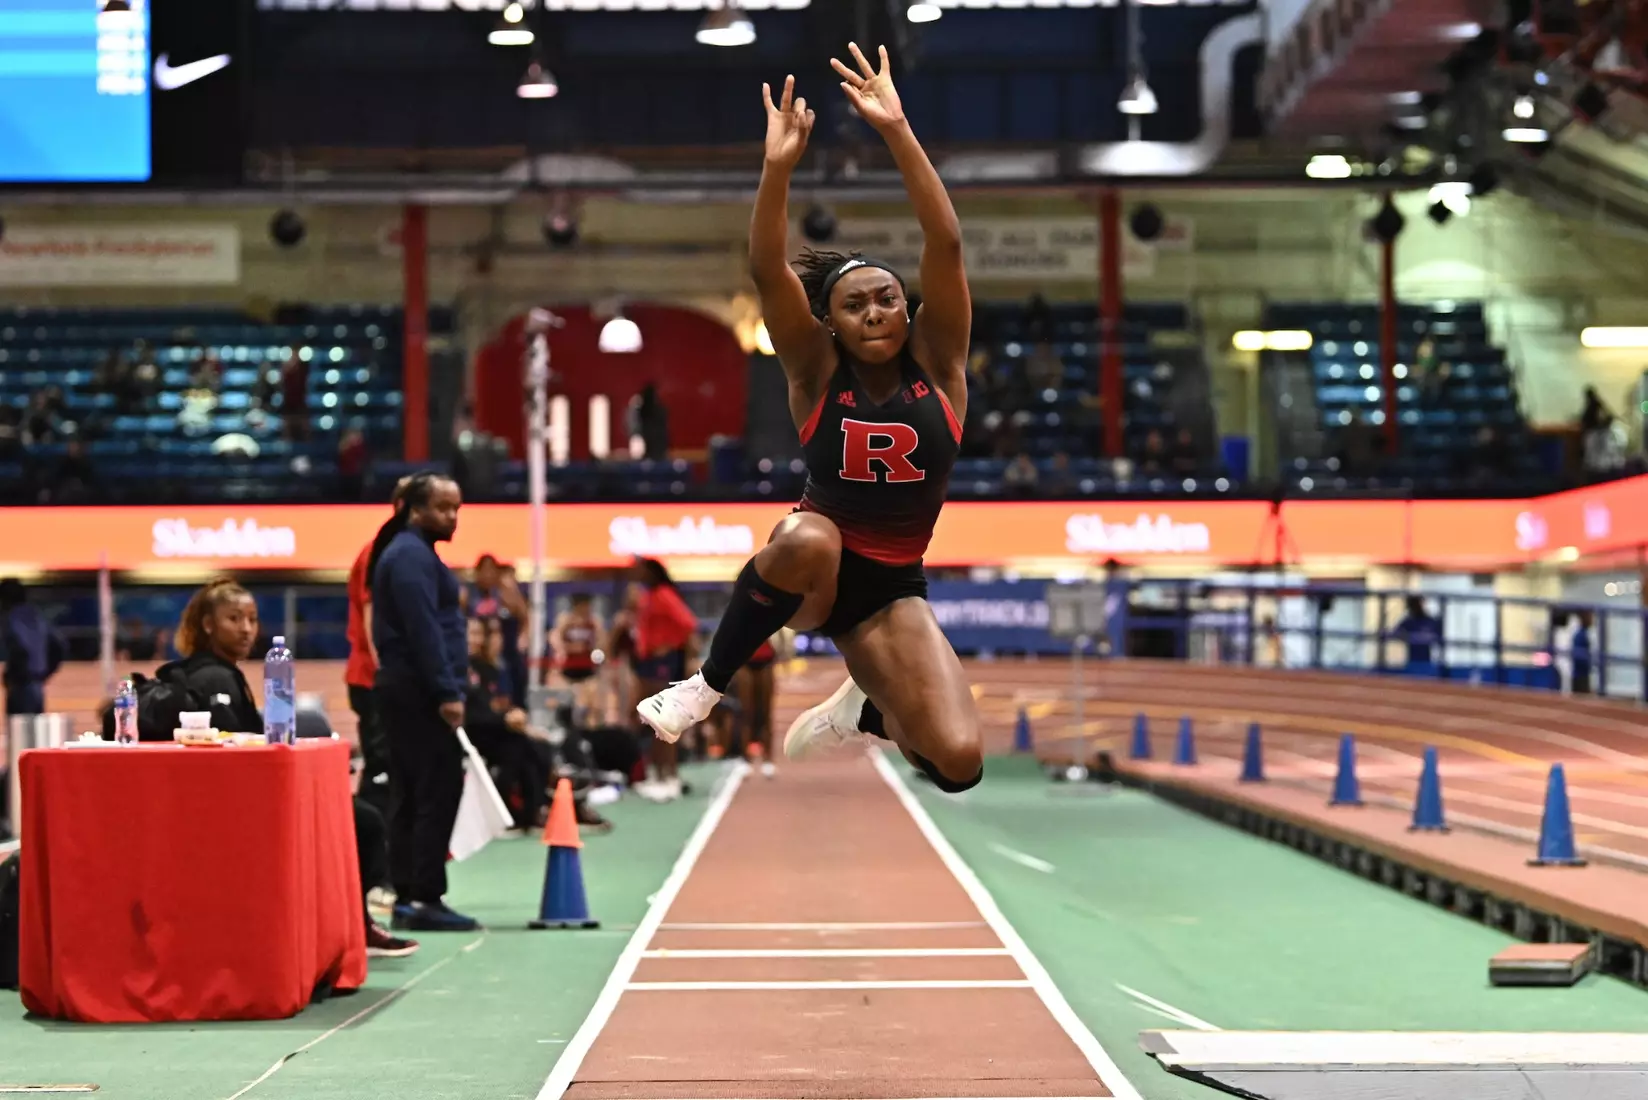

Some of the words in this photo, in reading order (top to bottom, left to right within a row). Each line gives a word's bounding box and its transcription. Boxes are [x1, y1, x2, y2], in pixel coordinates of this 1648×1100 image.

[839, 417, 925, 483] R
[152, 517, 295, 557] Skadden
[609, 516, 753, 555] Skadden
[1066, 513, 1210, 553] Skadden
